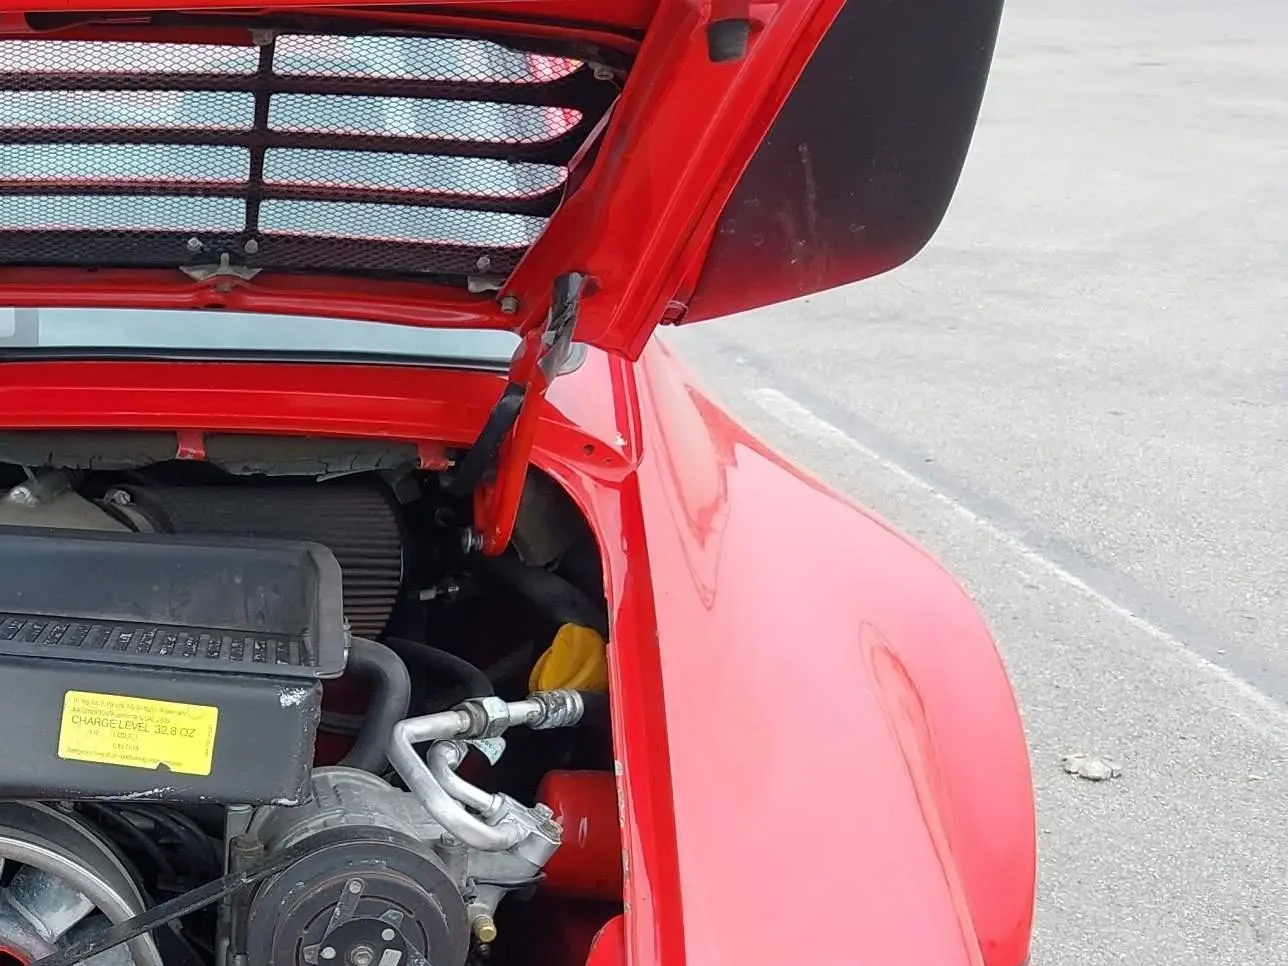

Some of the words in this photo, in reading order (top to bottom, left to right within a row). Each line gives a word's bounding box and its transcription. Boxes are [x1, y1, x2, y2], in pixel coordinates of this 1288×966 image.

[71, 714, 118, 729] CHARGE
[118, 719, 150, 733] LEVEL
[180, 727, 196, 738] OZ
